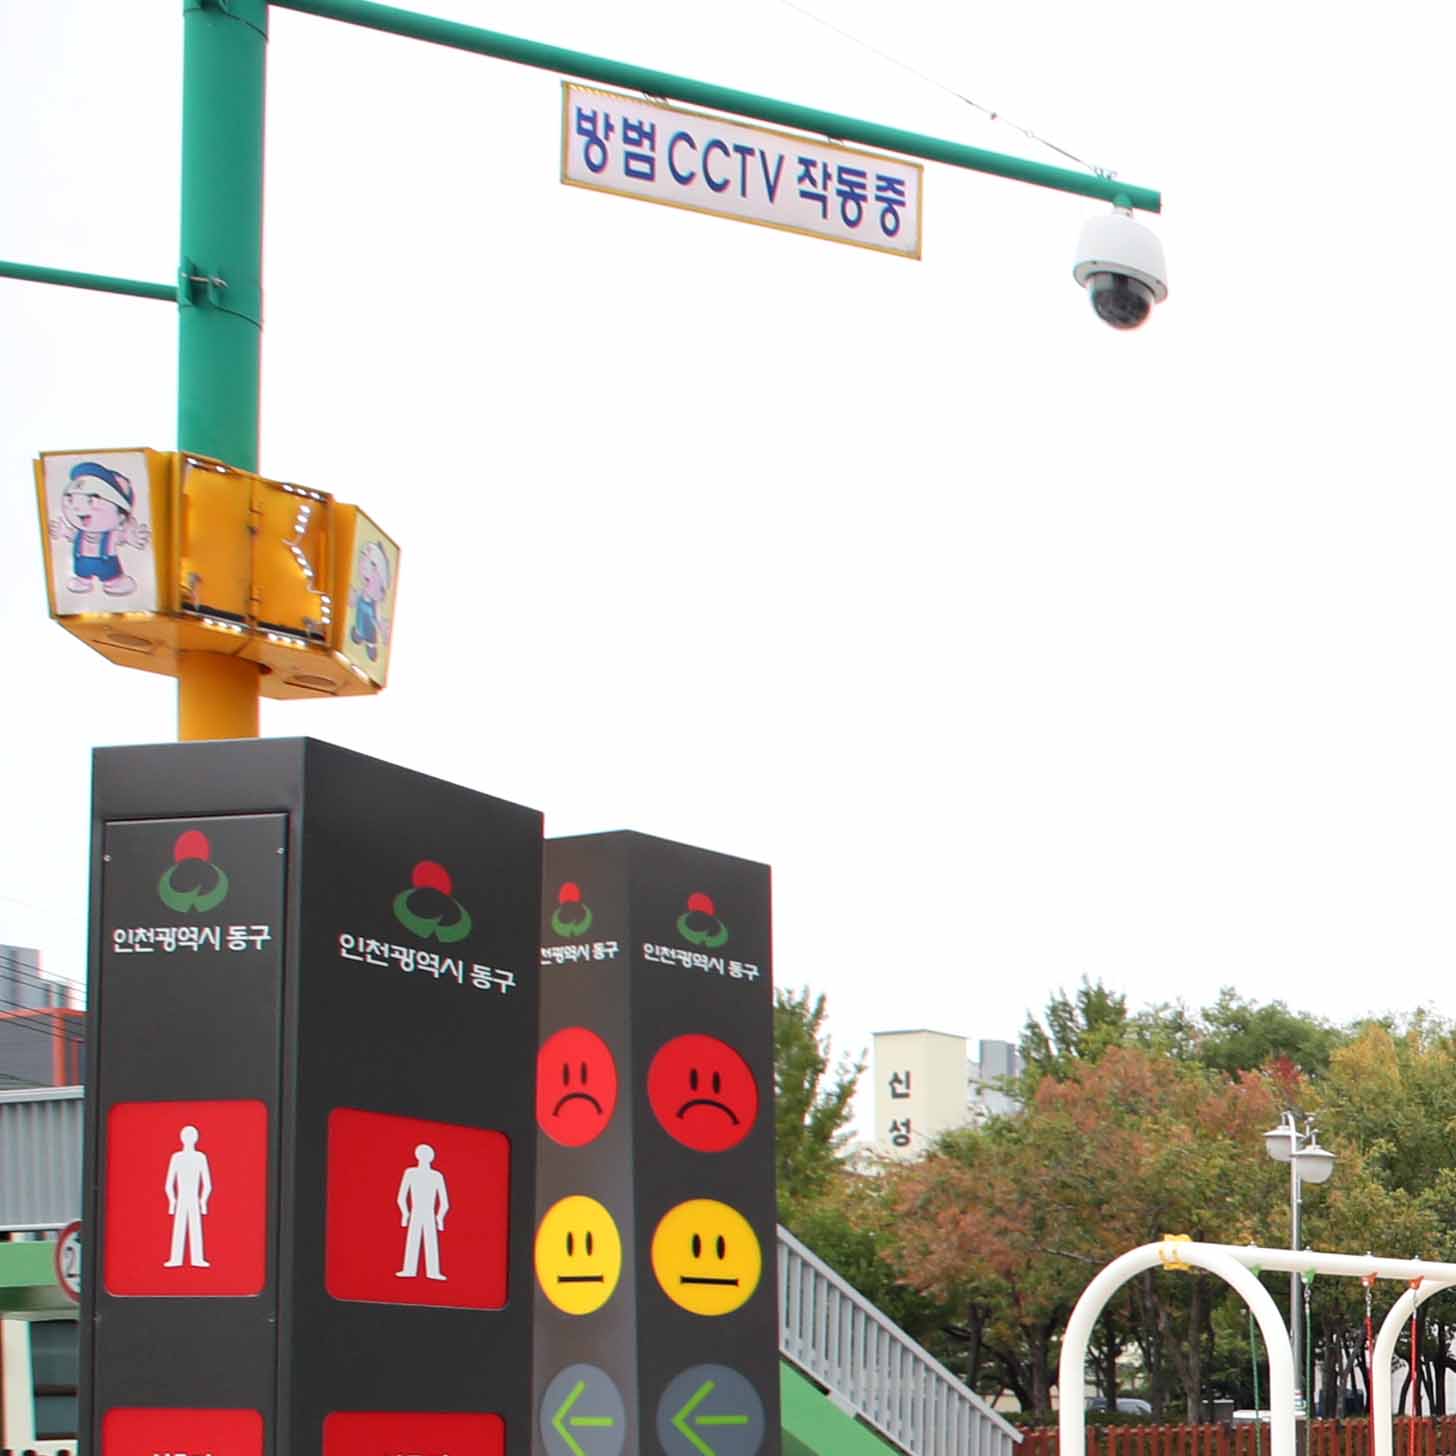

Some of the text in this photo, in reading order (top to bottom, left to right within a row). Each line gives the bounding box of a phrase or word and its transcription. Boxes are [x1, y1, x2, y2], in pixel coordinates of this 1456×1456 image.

[575, 105, 906, 238] 방범 CCTV 작동중
[112, 925, 272, 953] 인천광역시 동구
[338, 933, 517, 994] 인천광역시 동구
[592, 940, 620, 960] 동구
[643, 942, 760, 981] 인천광역시 동구
[888, 1070, 911, 1147] 신성
